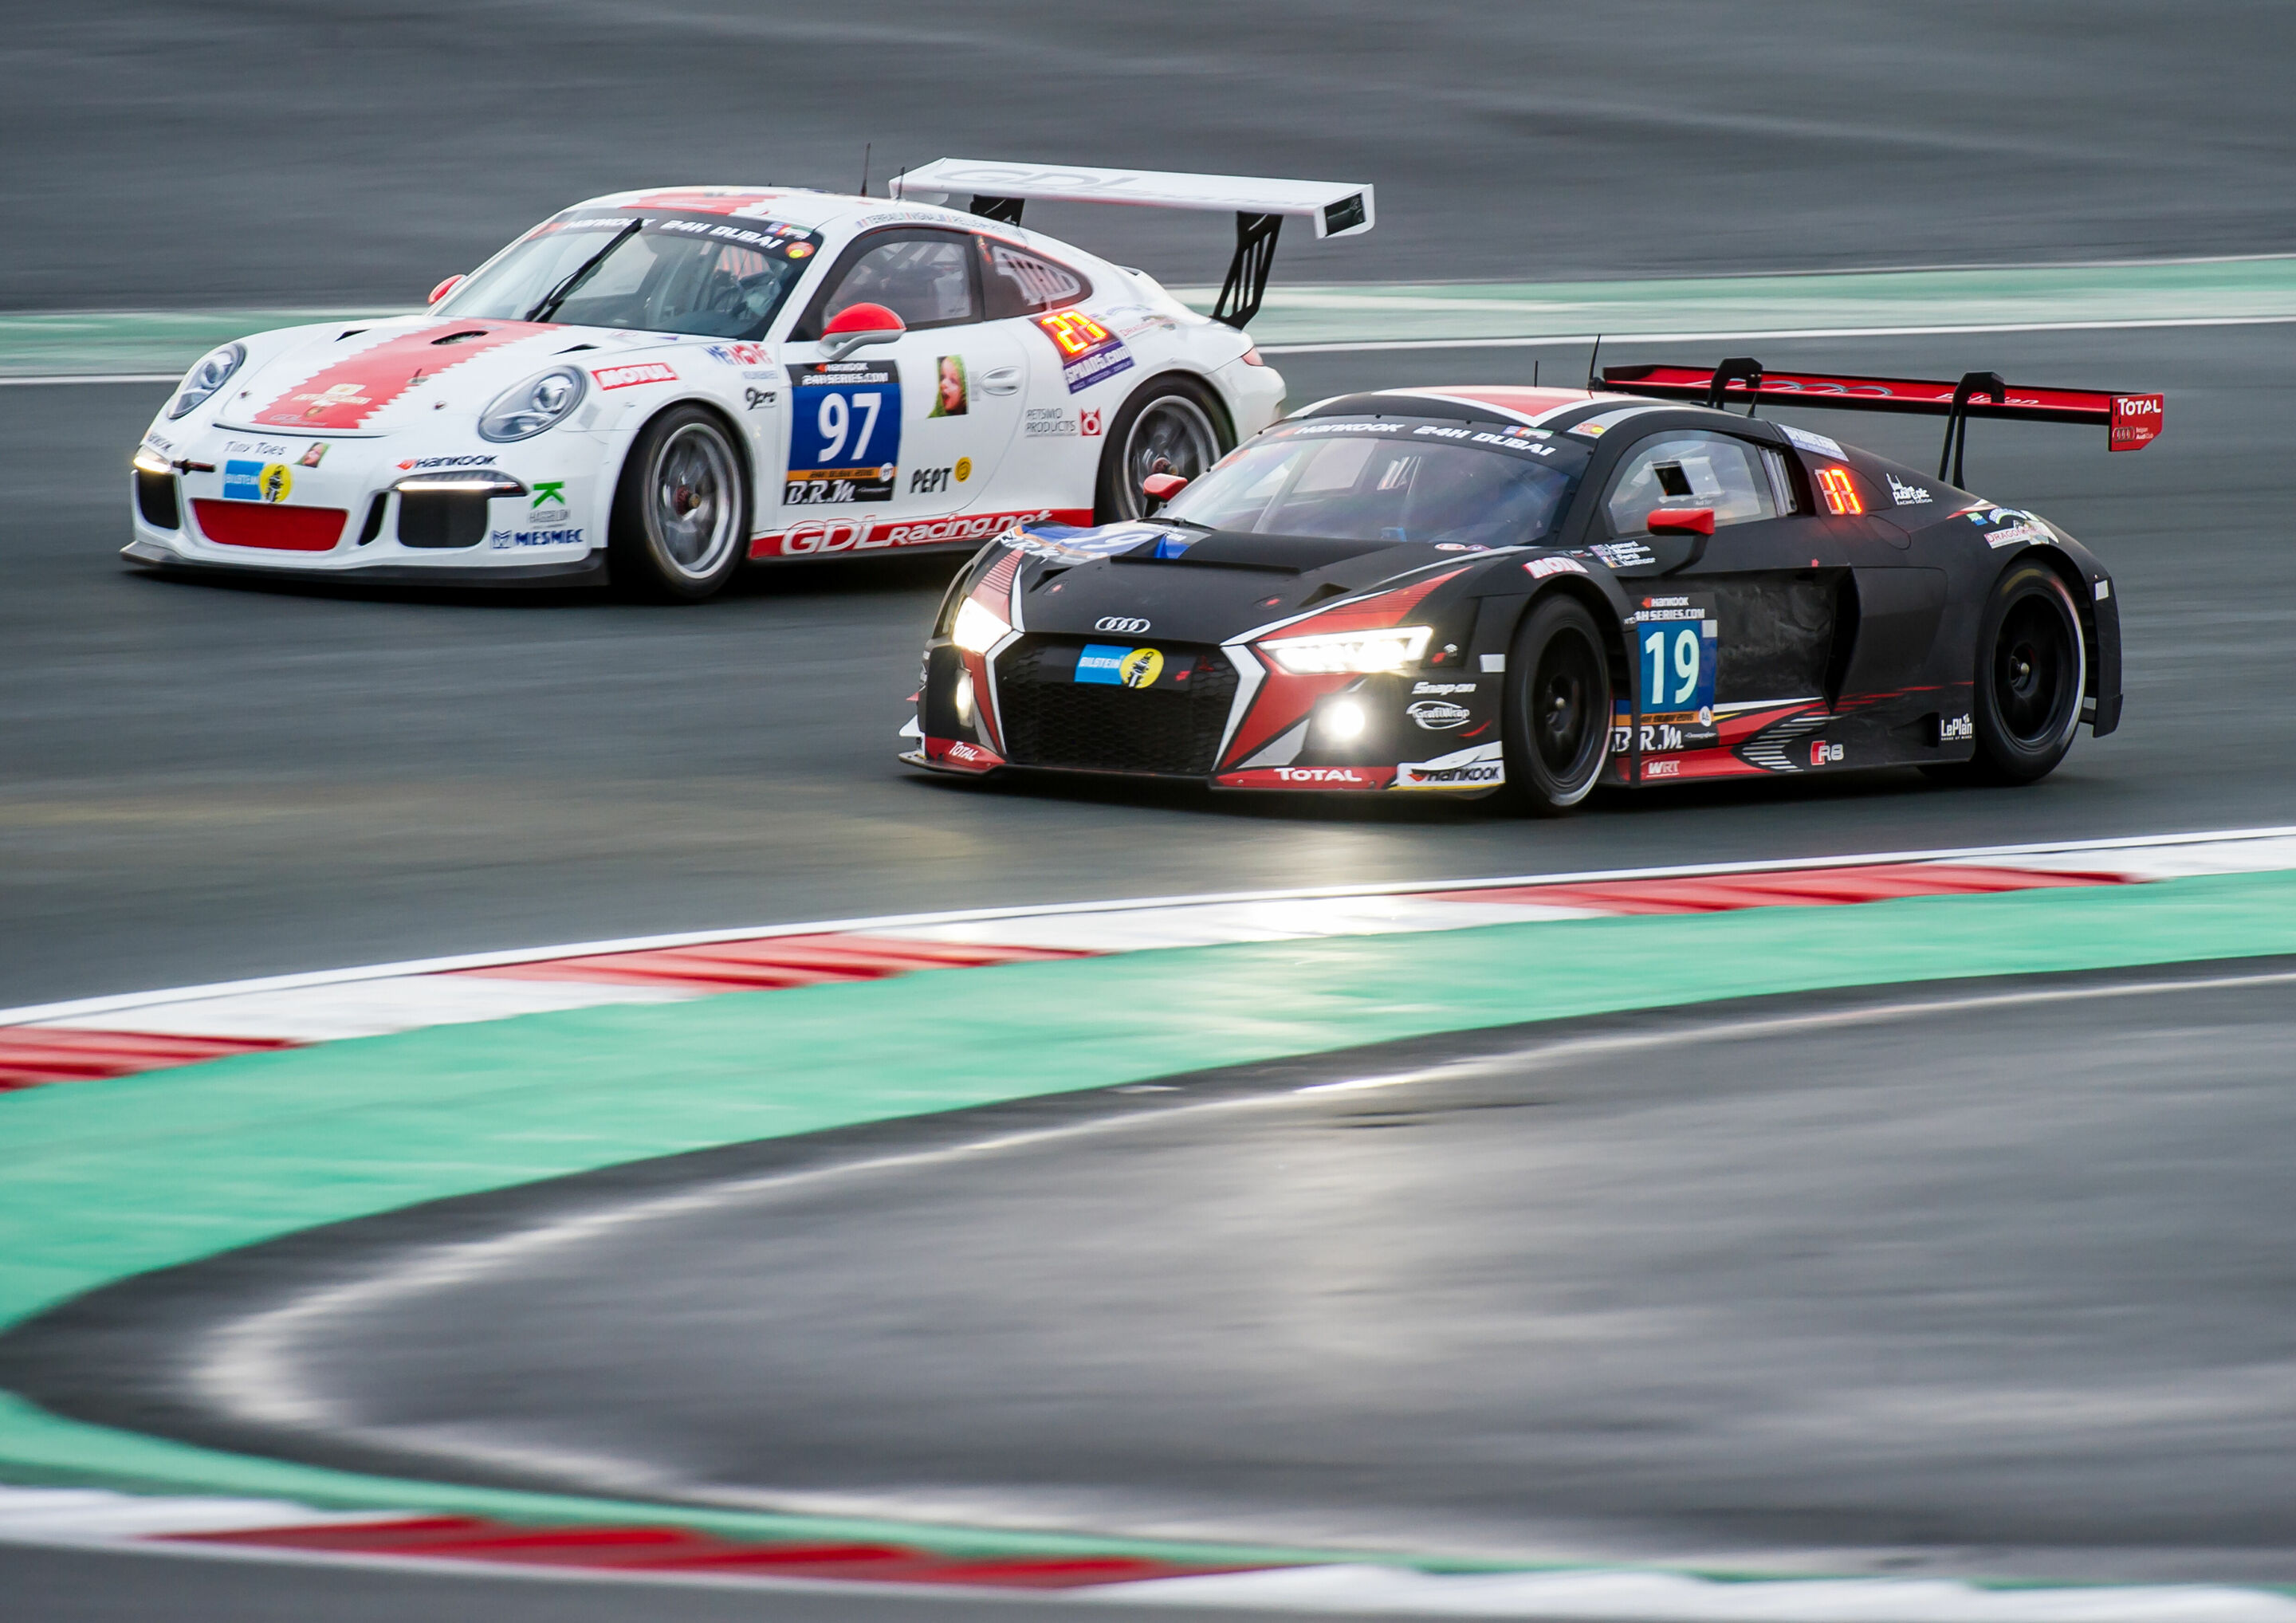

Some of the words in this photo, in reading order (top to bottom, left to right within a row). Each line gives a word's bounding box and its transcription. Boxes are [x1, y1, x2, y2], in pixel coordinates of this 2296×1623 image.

[659, 219, 712, 234] 24H
[708, 225, 784, 250] DUBAI
[1041, 310, 1107, 354] 27
[597, 364, 675, 387] MOTUL
[2117, 398, 2161, 416] TOTAL
[817, 392, 883, 463] 97
[1026, 420, 1076, 434] PRODUCTS
[1413, 425, 1472, 439] 24H
[1470, 432, 1557, 457] DUBAI
[515, 529, 585, 546] MESMEC
[1078, 656, 1122, 669] BILSTEIN
[1645, 629, 1700, 704] 19
[949, 740, 980, 762] TOTAL
[1818, 744, 1844, 761] R8
[1273, 767, 1362, 782] TOTAL
[1648, 760, 1681, 776] WRT
